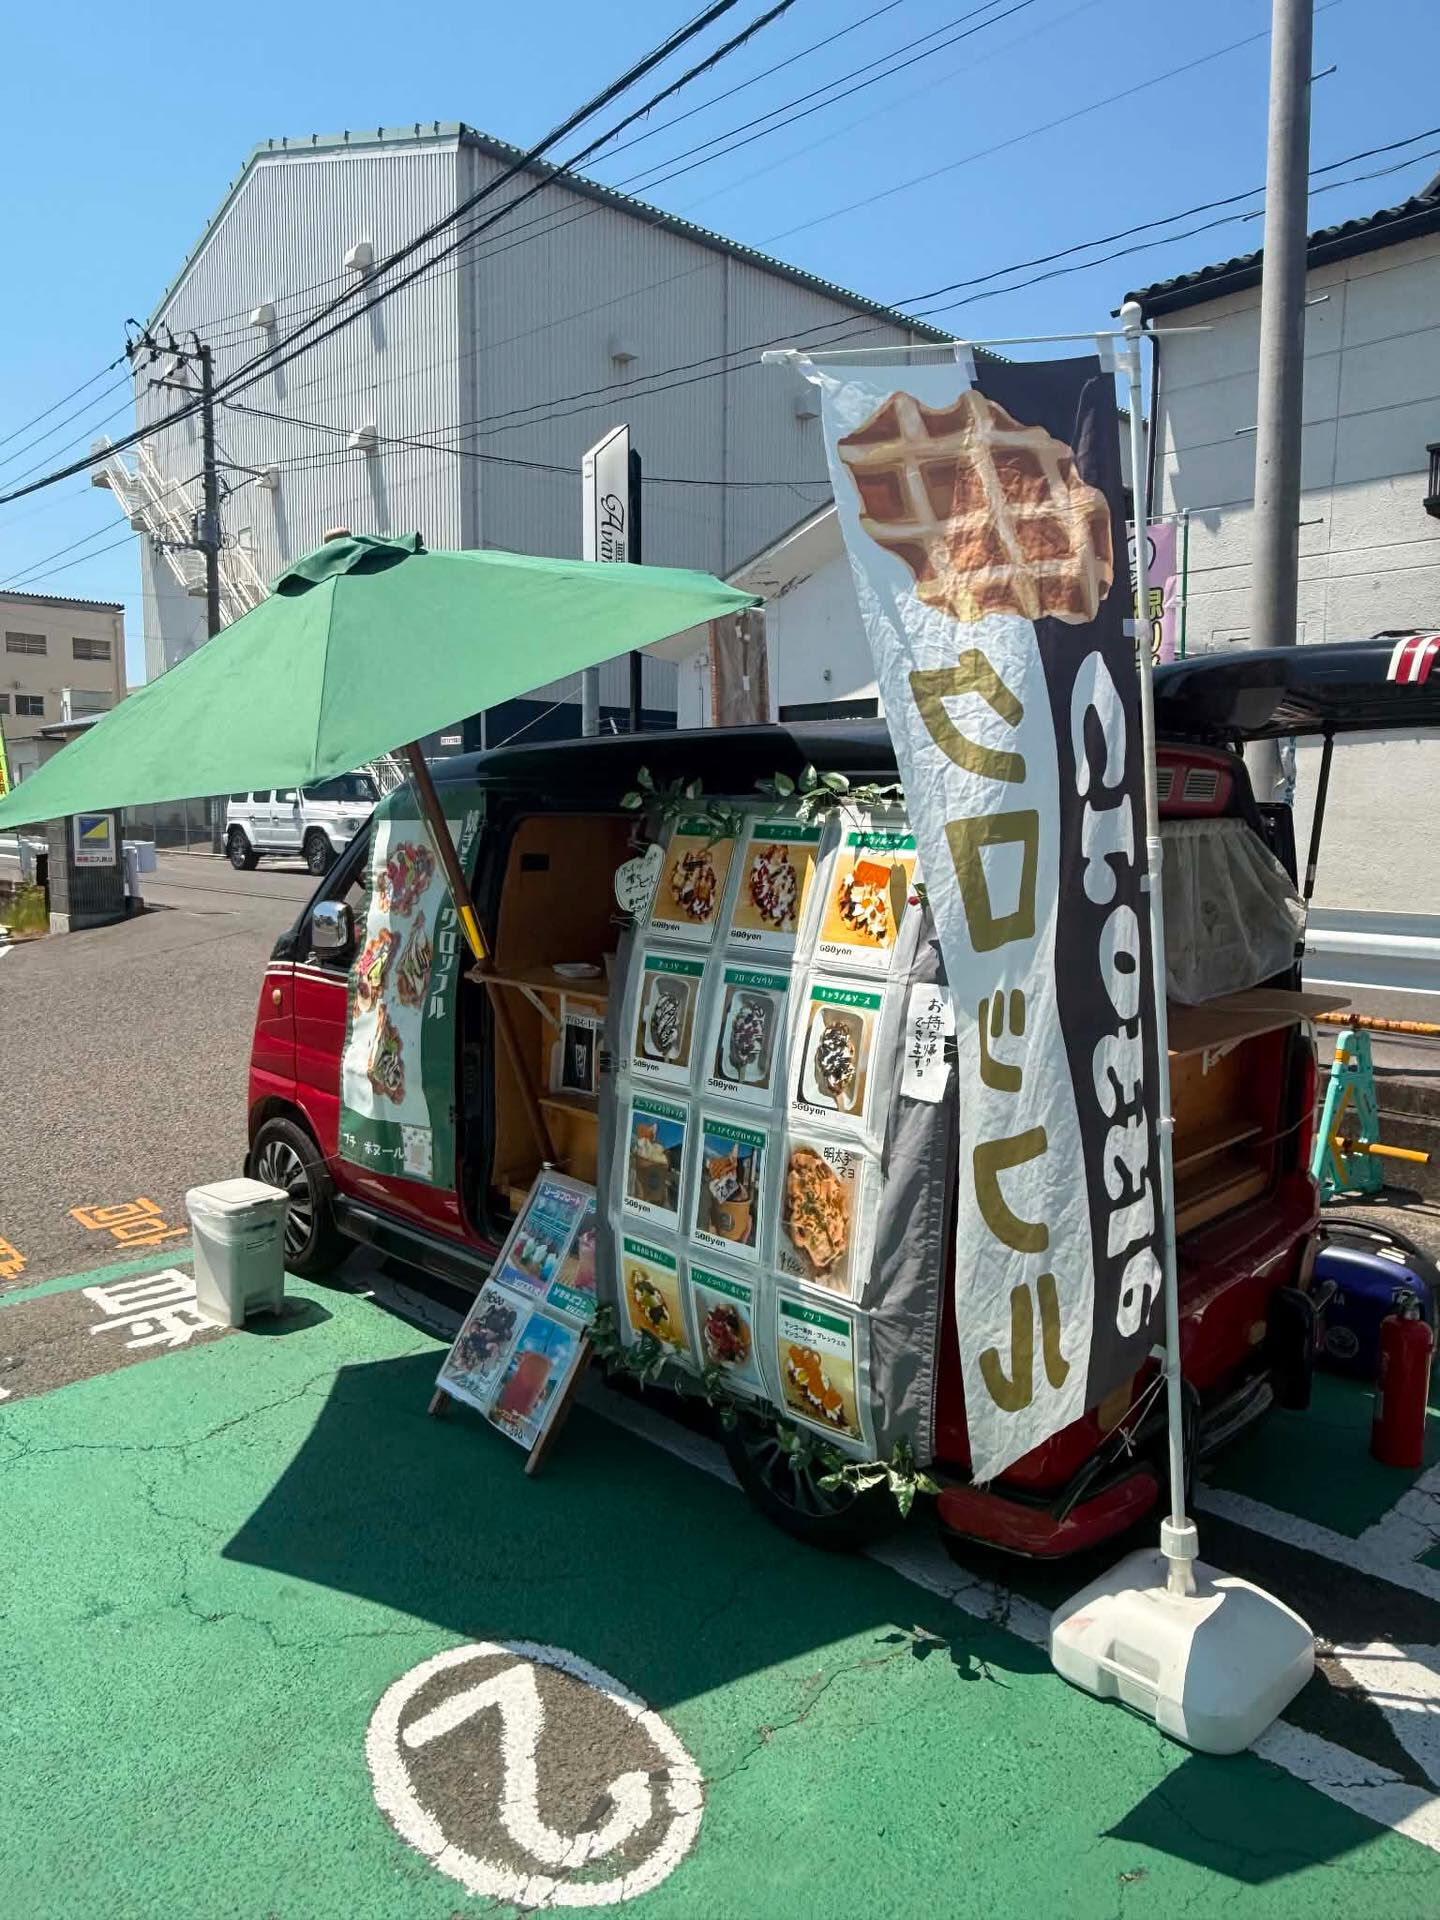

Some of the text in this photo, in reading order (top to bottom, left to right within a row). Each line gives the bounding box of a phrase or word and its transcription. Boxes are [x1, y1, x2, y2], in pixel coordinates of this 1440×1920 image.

[428, 908, 458, 1020] クロッフル
[923, 998, 945, 1066] お持ち帰り
[708, 1078, 738, 1092] 500yen
[823, 1147, 851, 1166] 明太子
[836, 1166, 855, 1179] マヨ
[403, 1663, 651, 1867] 2
